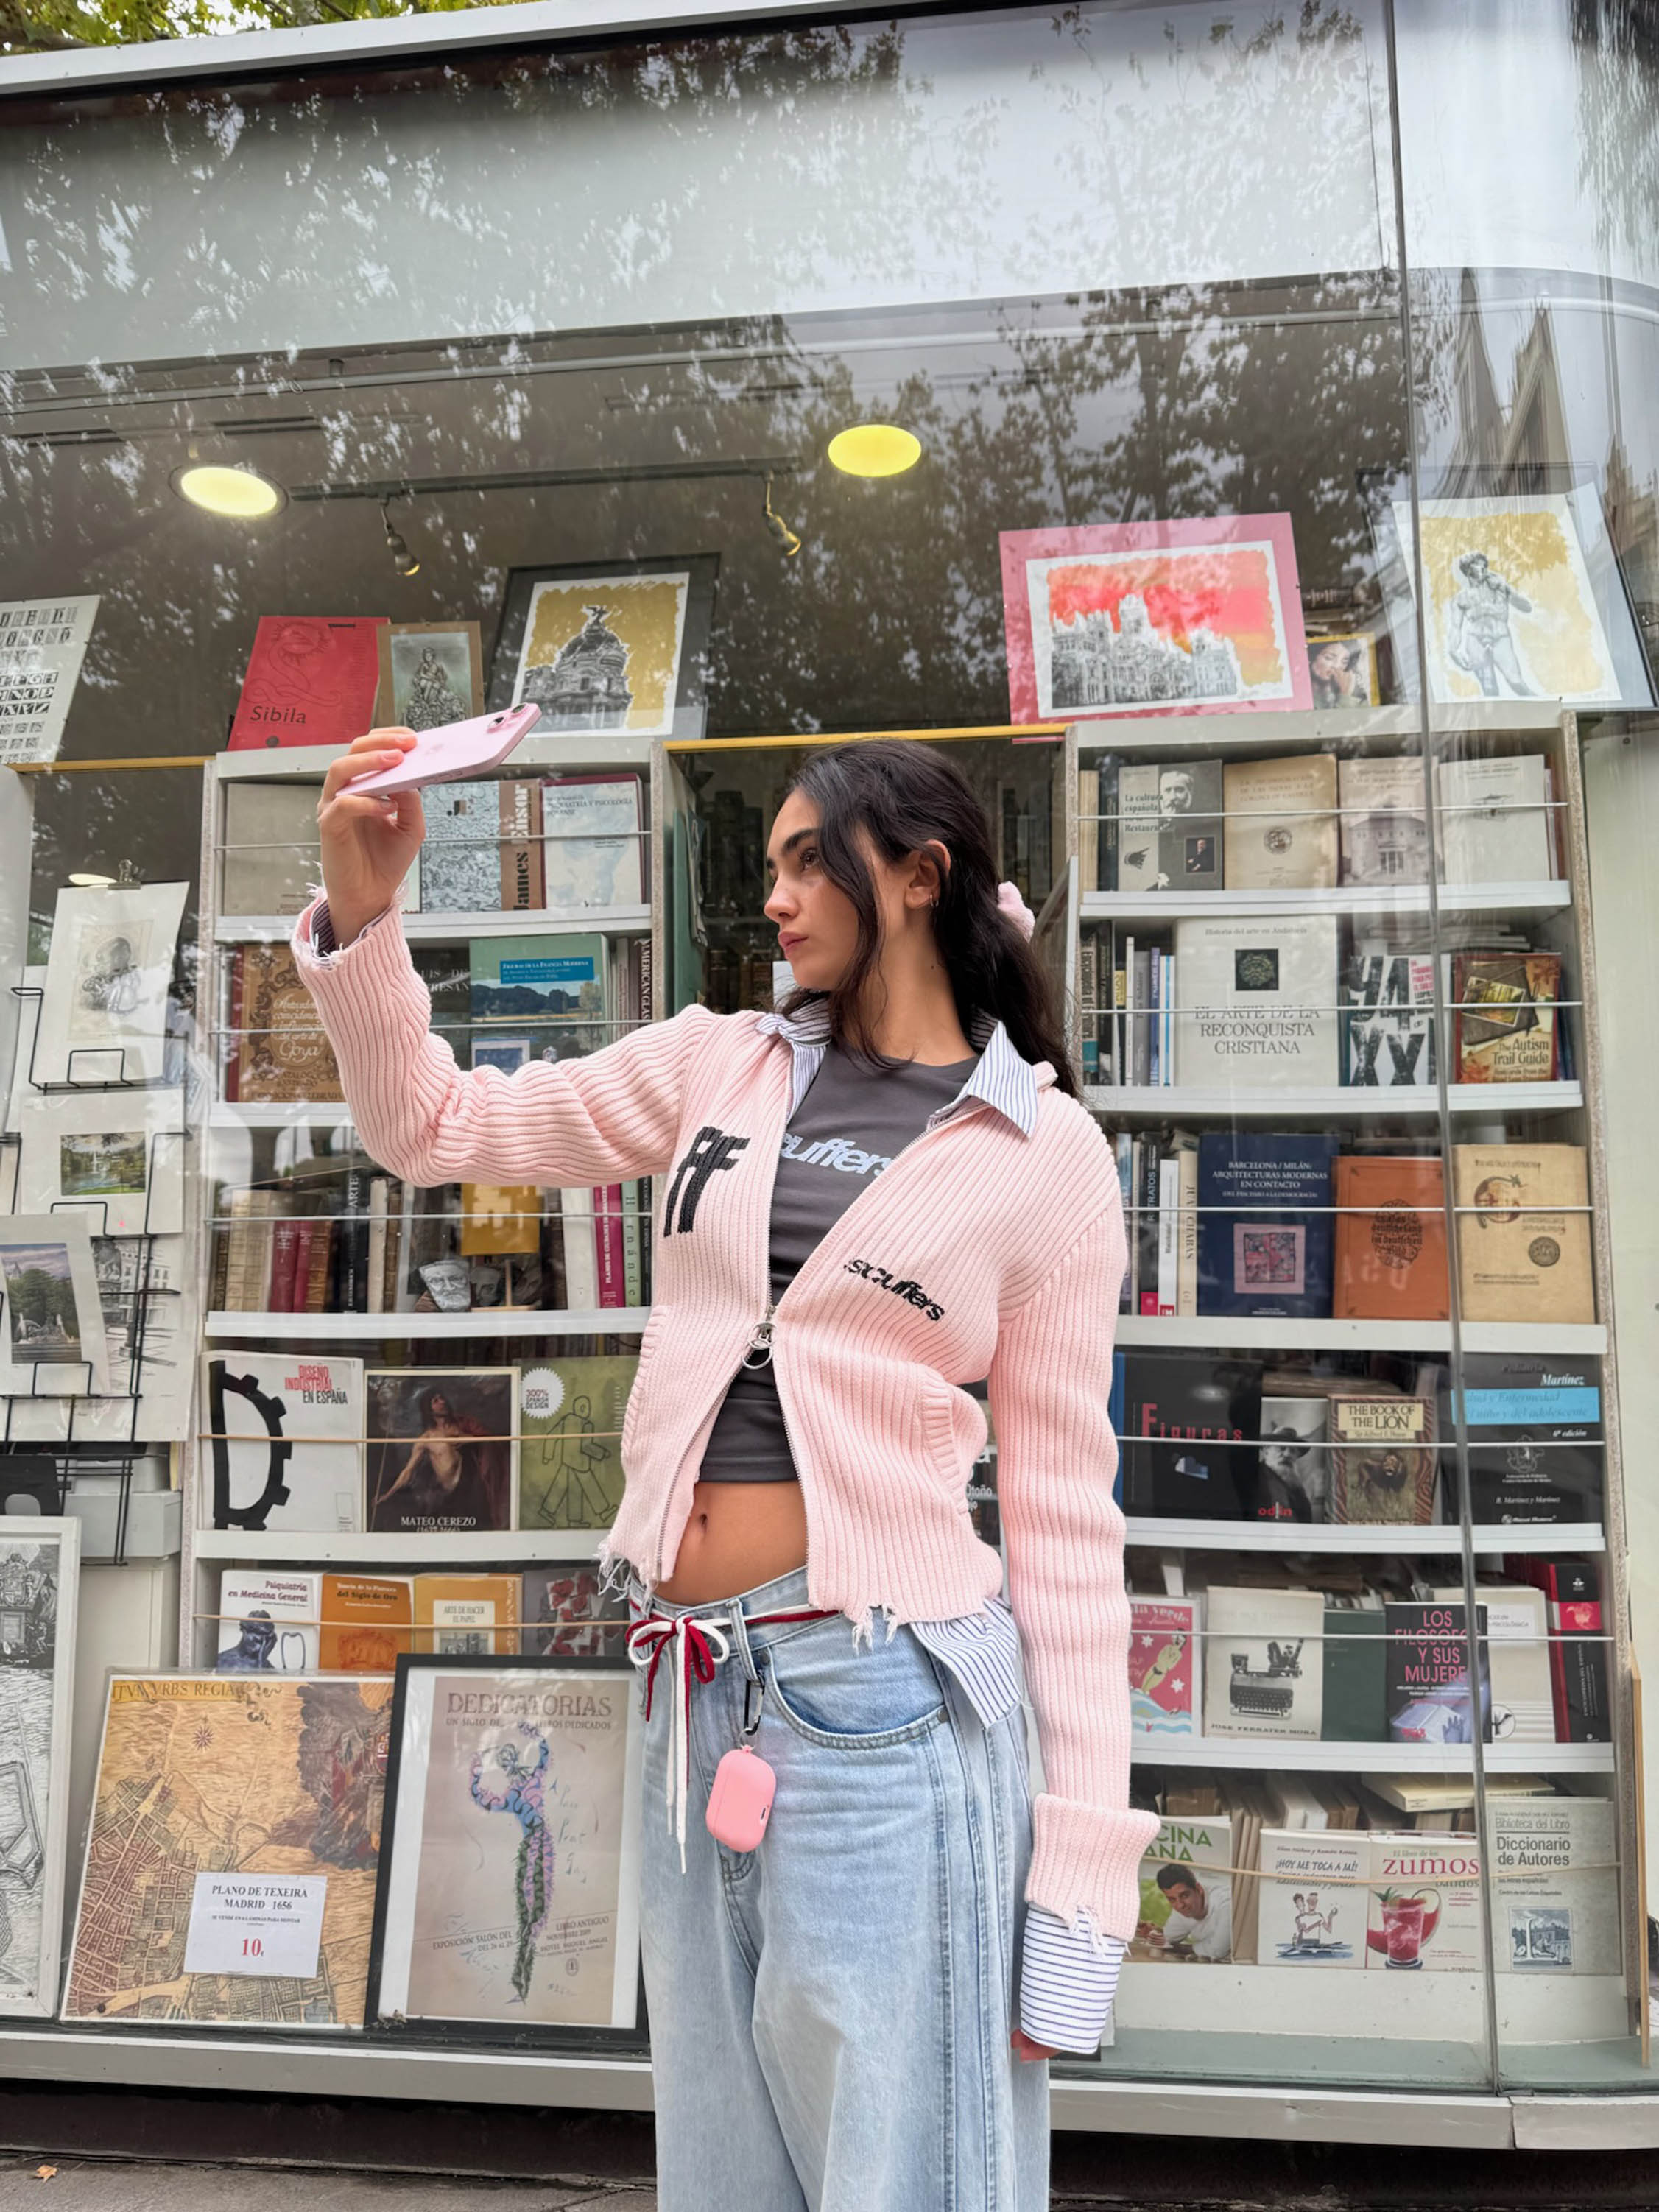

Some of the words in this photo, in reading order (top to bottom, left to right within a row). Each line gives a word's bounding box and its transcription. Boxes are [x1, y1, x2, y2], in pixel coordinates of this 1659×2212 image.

[250, 705, 307, 724] Sibila
[639, 940, 652, 995] AMERICAN
[640, 995, 652, 1020] GLAS
[1194, 1006, 1215, 1020] EL
[1221, 1005, 1265, 1020] ARTE
[1270, 1004, 1294, 1019] DE
[1298, 1004, 1320, 1019] LA
[1200, 1021, 1316, 1038] RECONQUISTA
[279, 1040, 322, 1063] Goya
[1214, 1039, 1301, 1055] CRISTIANA
[1512, 1037, 1549, 1052] Autism
[1492, 1052, 1515, 1066] Trail
[1517, 1051, 1549, 1065] Guide
[1228, 1160, 1278, 1170] BARCELONA
[1212, 1170, 1281, 1180] ARQUITECTURAS
[1282, 1172, 1328, 1180] MODERNAS
[1240, 1180, 1253, 1188] EN
[1253, 1180, 1301, 1188] CONTACTO
[348, 1177, 360, 1208] ARTE
[1146, 1172, 1158, 1222] RTRATOS
[1186, 1185, 1196, 1208] JUA
[299, 1362, 329, 1378] DISEÑO
[1540, 1372, 1585, 1387] Martínez
[303, 1389, 314, 1403] EN
[317, 1388, 348, 1404] ESPAÑA
[526, 1388, 549, 1398] 300%
[1347, 1405, 1368, 1415] THE
[1370, 1405, 1400, 1416] BOOK
[1400, 1406, 1415, 1415] OF
[1351, 1417, 1374, 1427] THE
[1375, 1416, 1410, 1430] LION
[1561, 1428, 1588, 1437] edición
[401, 1516, 435, 1526] MATEO
[437, 1516, 477, 1526] CEREZO
[239, 1590, 277, 1600] Medicina
[278, 1593, 309, 1603] General
[351, 1591, 371, 1600] Siglo
[1423, 1610, 1453, 1627] LOS
[1417, 1647, 1429, 1664] Y
[1432, 1647, 1462, 1664] SUS
[1404, 1666, 1468, 1683] MUJERE
[152, 1681, 189, 1697] VRBS
[193, 1681, 236, 1697] REGIA
[447, 1692, 613, 1718] DEDICATORIAS
[445, 1717, 458, 1726] UN
[462, 1717, 486, 1727] SIGLO
[564, 1720, 612, 1730] DEDICADOS
[1211, 1723, 1234, 1731] JOSE
[1236, 1725, 1287, 1734] FERRATER
[1289, 1727, 1318, 1736] MORA
[1496, 1817, 1533, 1829] Biblioteca
[1535, 1818, 1548, 1829] del
[1549, 1819, 1571, 1830] Libro
[1496, 1836, 1571, 1851] Diccionario
[1297, 1860, 1310, 1870] ME
[1311, 1861, 1332, 1871] TOCA
[1334, 1861, 1341, 1871] A
[1381, 1857, 1479, 1875] zumos
[1498, 1851, 1515, 1866] de
[1518, 1851, 1571, 1867] Autores
[211, 1884, 246, 1895] PLANO
[247, 1886, 262, 1896] DE
[264, 1887, 309, 1898] TEXEIRA
[224, 1898, 266, 1909] MADRID
[272, 1901, 293, 1911] 1656
[432, 1934, 473, 1951] EXPOSICIÓN
[499, 1930, 513, 1940] DEL
[577, 1916, 610, 1929] ANTIGUO
